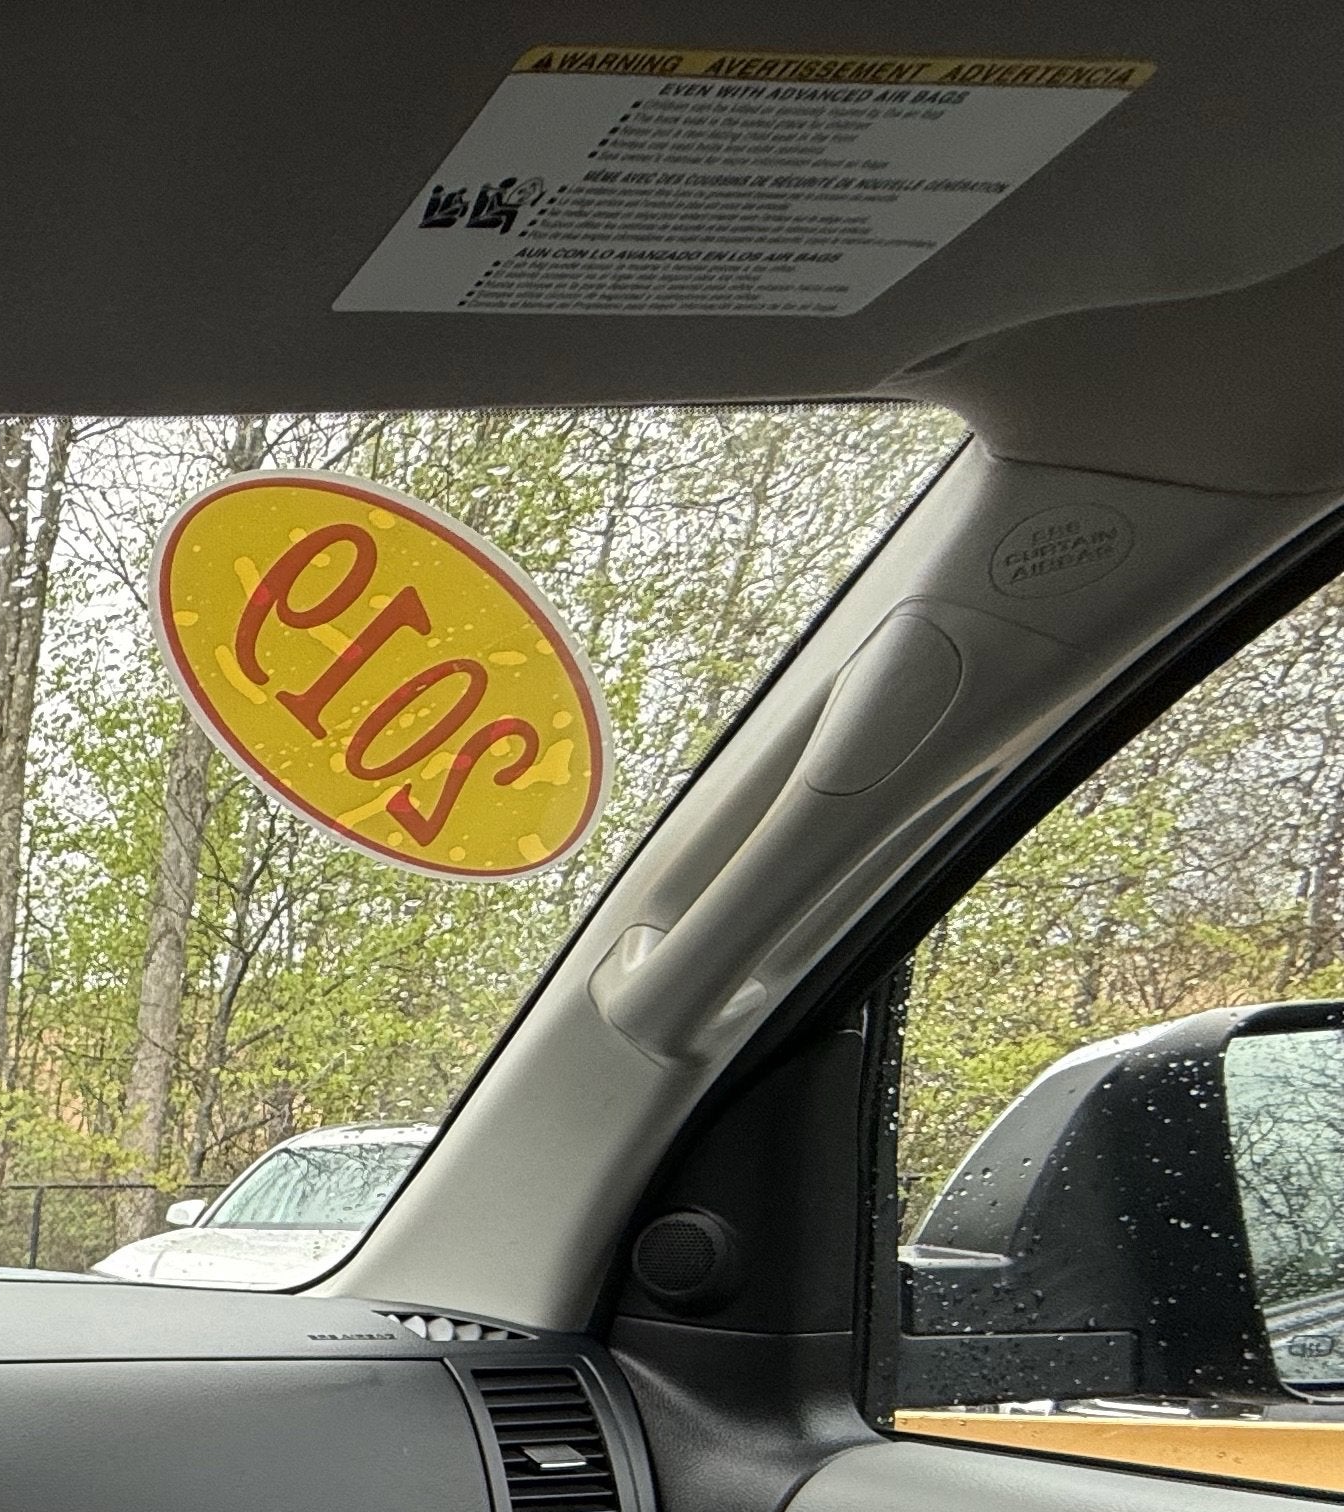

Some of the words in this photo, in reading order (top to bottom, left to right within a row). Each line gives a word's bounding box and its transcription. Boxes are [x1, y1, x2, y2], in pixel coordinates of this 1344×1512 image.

[556, 52, 683, 73] WARNING
[701, 56, 932, 80] AVERTISSEMENT
[940, 63, 1137, 84] ADVERTENCIA
[658, 83, 714, 97] EVEN
[718, 85, 766, 98] WITH
[767, 86, 873, 102] ADVANCED
[874, 89, 911, 103] AIR
[514, 248, 554, 260] AUN
[552, 248, 591, 260] CON
